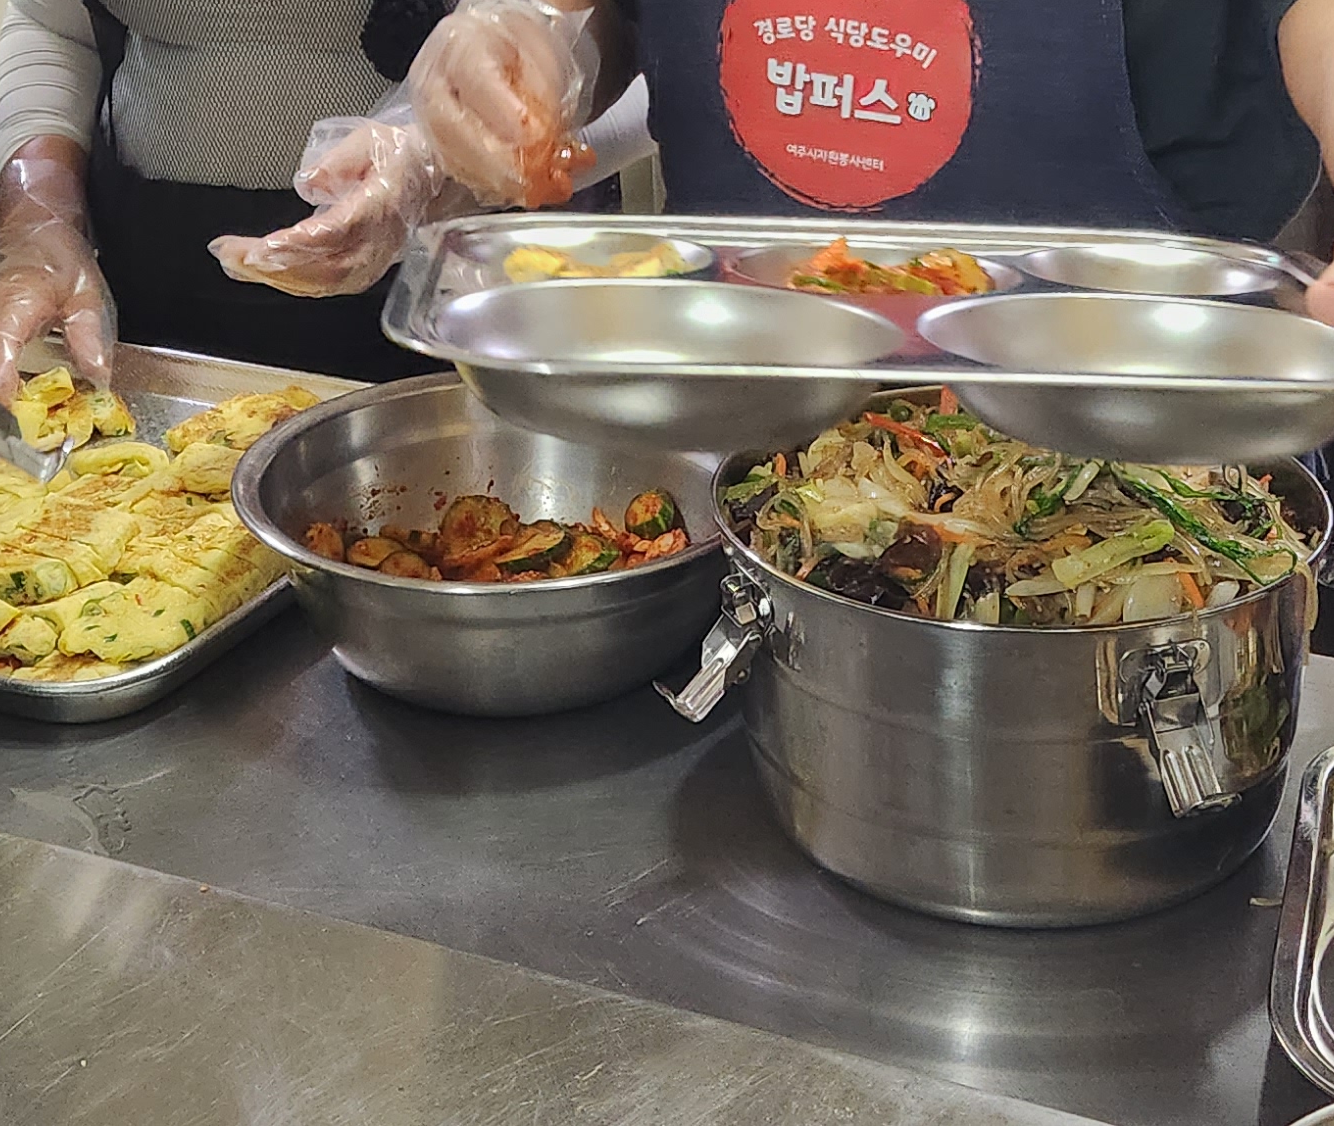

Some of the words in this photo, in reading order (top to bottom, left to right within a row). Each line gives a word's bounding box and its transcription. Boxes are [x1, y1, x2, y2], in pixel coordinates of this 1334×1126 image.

[753, 15, 817, 44] 경로당
[824, 17, 937, 69] 식당도우미
[767, 57, 903, 124] 밥퍼스
[785, 143, 885, 172] 여주시자원봉사센터
